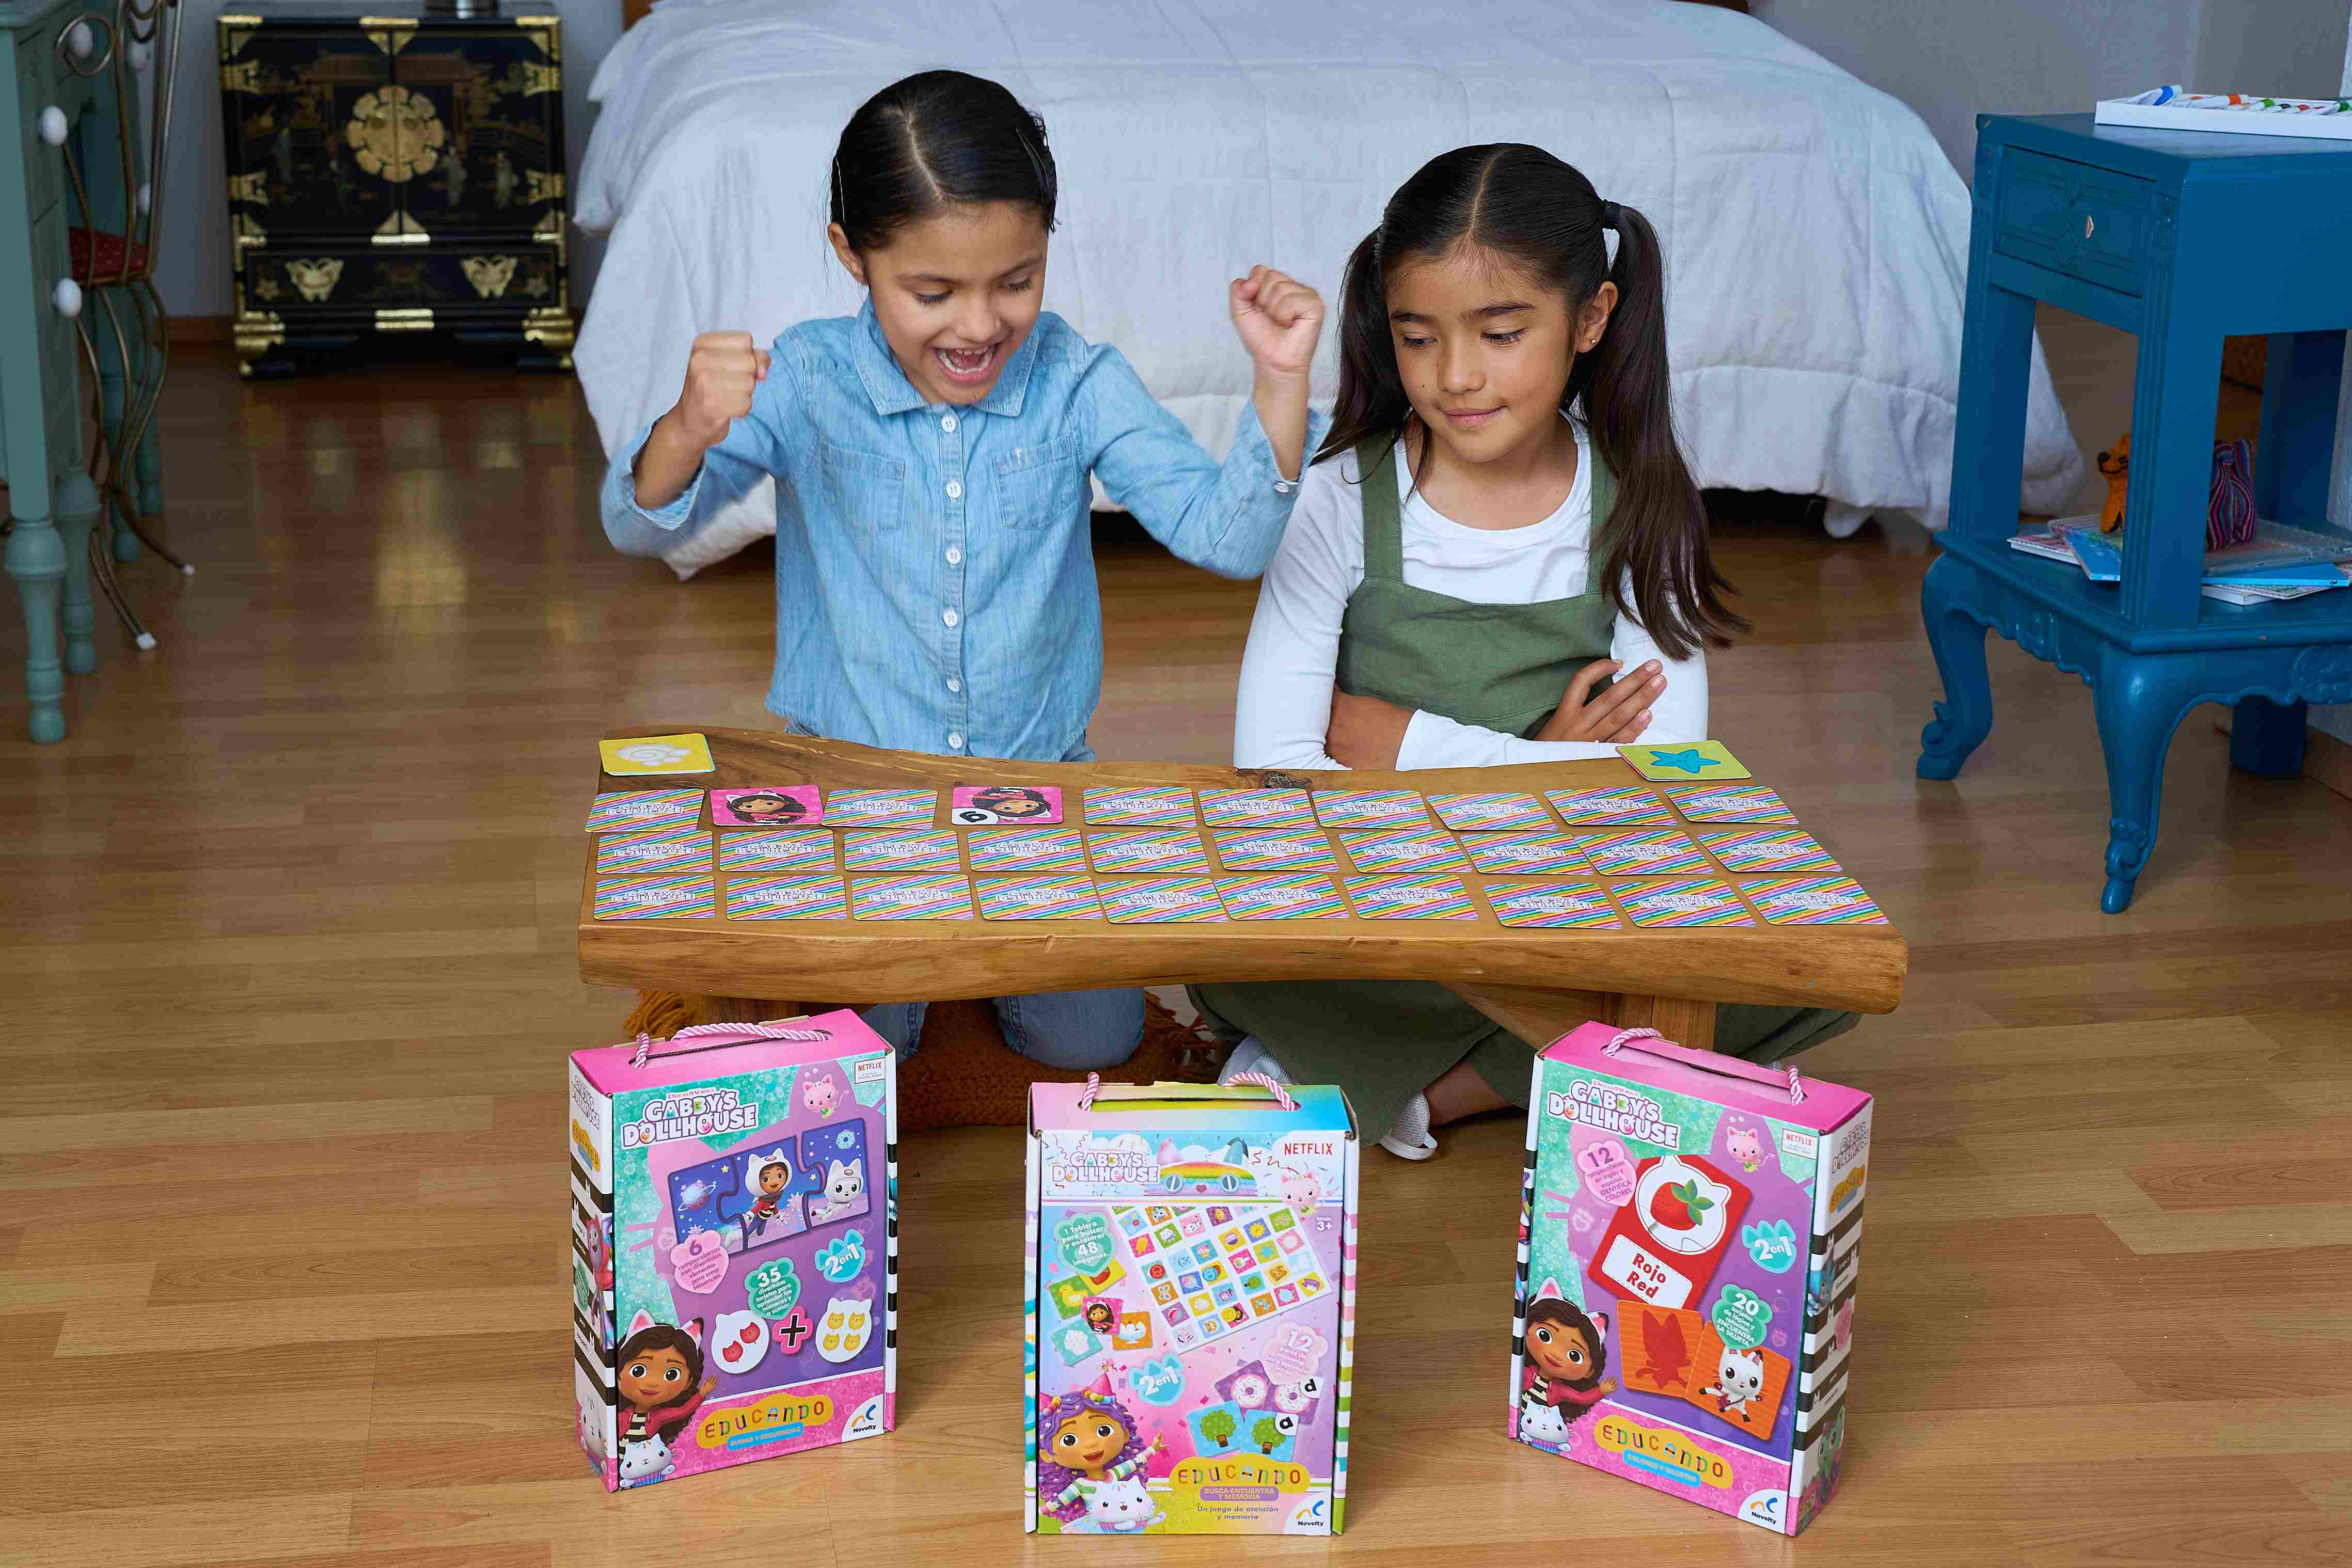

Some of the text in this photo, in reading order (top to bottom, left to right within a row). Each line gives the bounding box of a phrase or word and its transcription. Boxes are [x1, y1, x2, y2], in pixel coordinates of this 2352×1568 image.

[858, 1062, 882, 1072] NETFLIX
[645, 1090, 738, 1123] GABBY'S
[1570, 1081, 1660, 1123] GABBY'S
[623, 1104, 756, 1147] DOLLHOUSE
[1549, 1092, 1678, 1148] DOLLHOUSE
[1786, 1133, 1812, 1147] NETFLIX
[1284, 1143, 1333, 1155] NETFLIX
[1587, 1147, 1615, 1167] 12
[1070, 1151, 1144, 1167] GABBY'S
[1052, 1165, 1159, 1182] DOLLHOUSE
[1600, 1180, 1632, 1196] IDENTIFICA
[1062, 1226, 1104, 1244] para buscar
[1069, 1222, 1098, 1233] Tablero
[690, 1240, 703, 1256] 6
[1071, 1233, 1105, 1247] encontrar
[1078, 1241, 1099, 1256] 48
[1632, 1252, 1666, 1284] Rojo
[691, 1275, 705, 1286] para
[757, 1266, 781, 1288] 35
[1627, 1271, 1660, 1298] Red
[778, 1283, 792, 1294] para
[1731, 1293, 1760, 1316] 20
[1717, 1318, 1755, 1343] ENCUENTRA
[1288, 1331, 1313, 1352] 12
[1304, 1378, 1317, 1392] d
[705, 1401, 825, 1439] EDUCANDO
[853, 1424, 877, 1433] Novelty
[1279, 1416, 1294, 1430] a
[1602, 1424, 1724, 1478] EDUCANDO
[1177, 1464, 1301, 1485] EDUCANDO
[1751, 1511, 1777, 1525] Novelty
